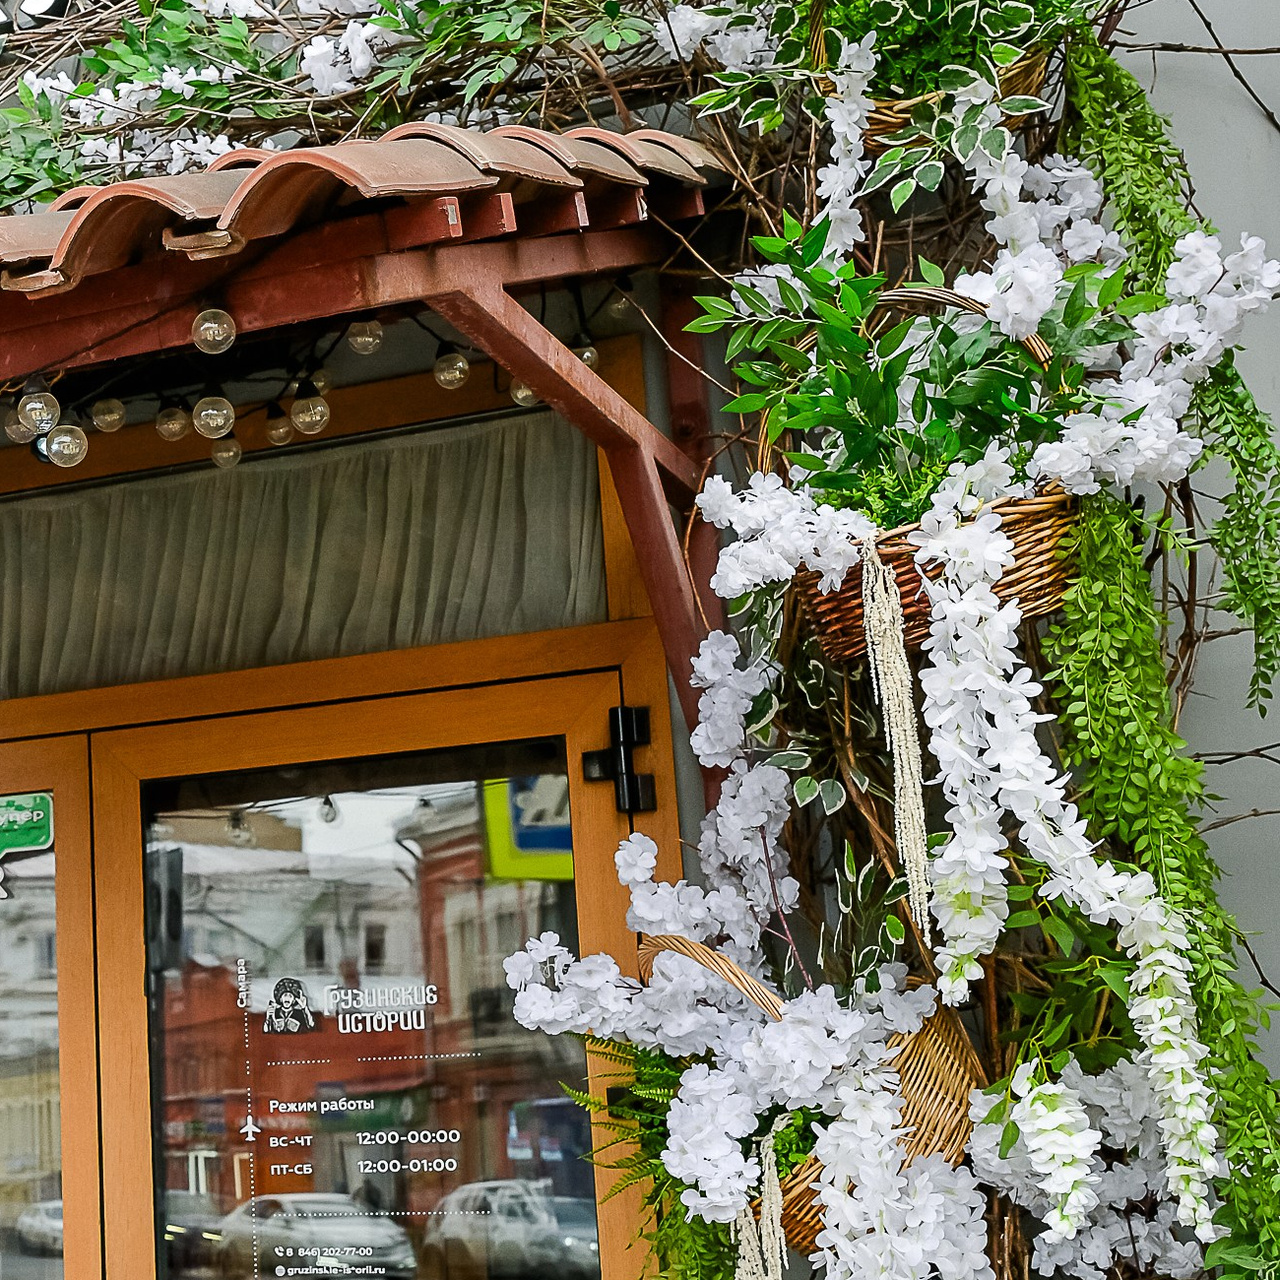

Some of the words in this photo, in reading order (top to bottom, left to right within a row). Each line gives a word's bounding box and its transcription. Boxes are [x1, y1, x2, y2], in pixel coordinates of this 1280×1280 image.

[236, 958, 248, 1009] Самара
[269, 1099, 318, 1114] Режим
[321, 1097, 375, 1115] работы
[355, 1129, 461, 1145] 12:00-00:00
[357, 1158, 458, 1173] 12:00-01:00
[286, 1247, 294, 1257] 8
[322, 1246, 373, 1257] 202-77-00
